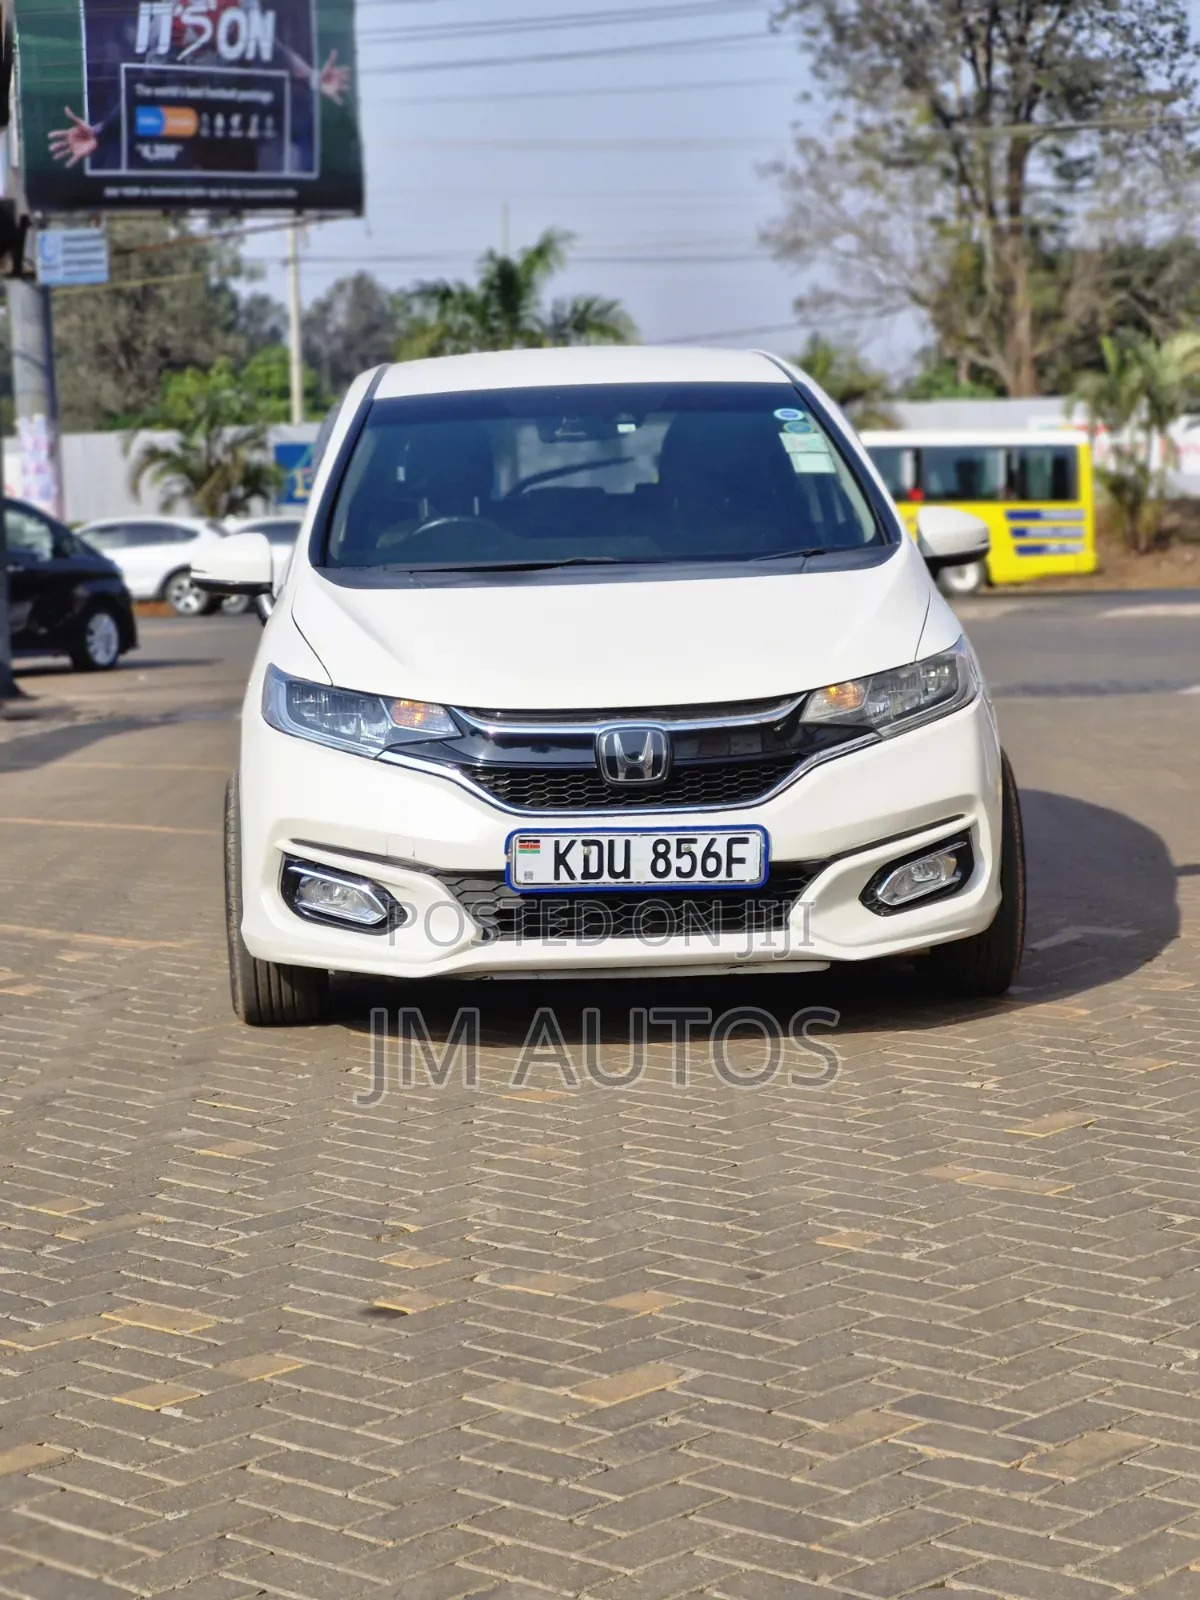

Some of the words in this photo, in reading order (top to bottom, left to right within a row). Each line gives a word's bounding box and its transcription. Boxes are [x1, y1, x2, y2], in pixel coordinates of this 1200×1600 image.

[217, 7, 277, 62] ON
[553, 838, 632, 881] KDU
[650, 836, 750, 879] 856F
